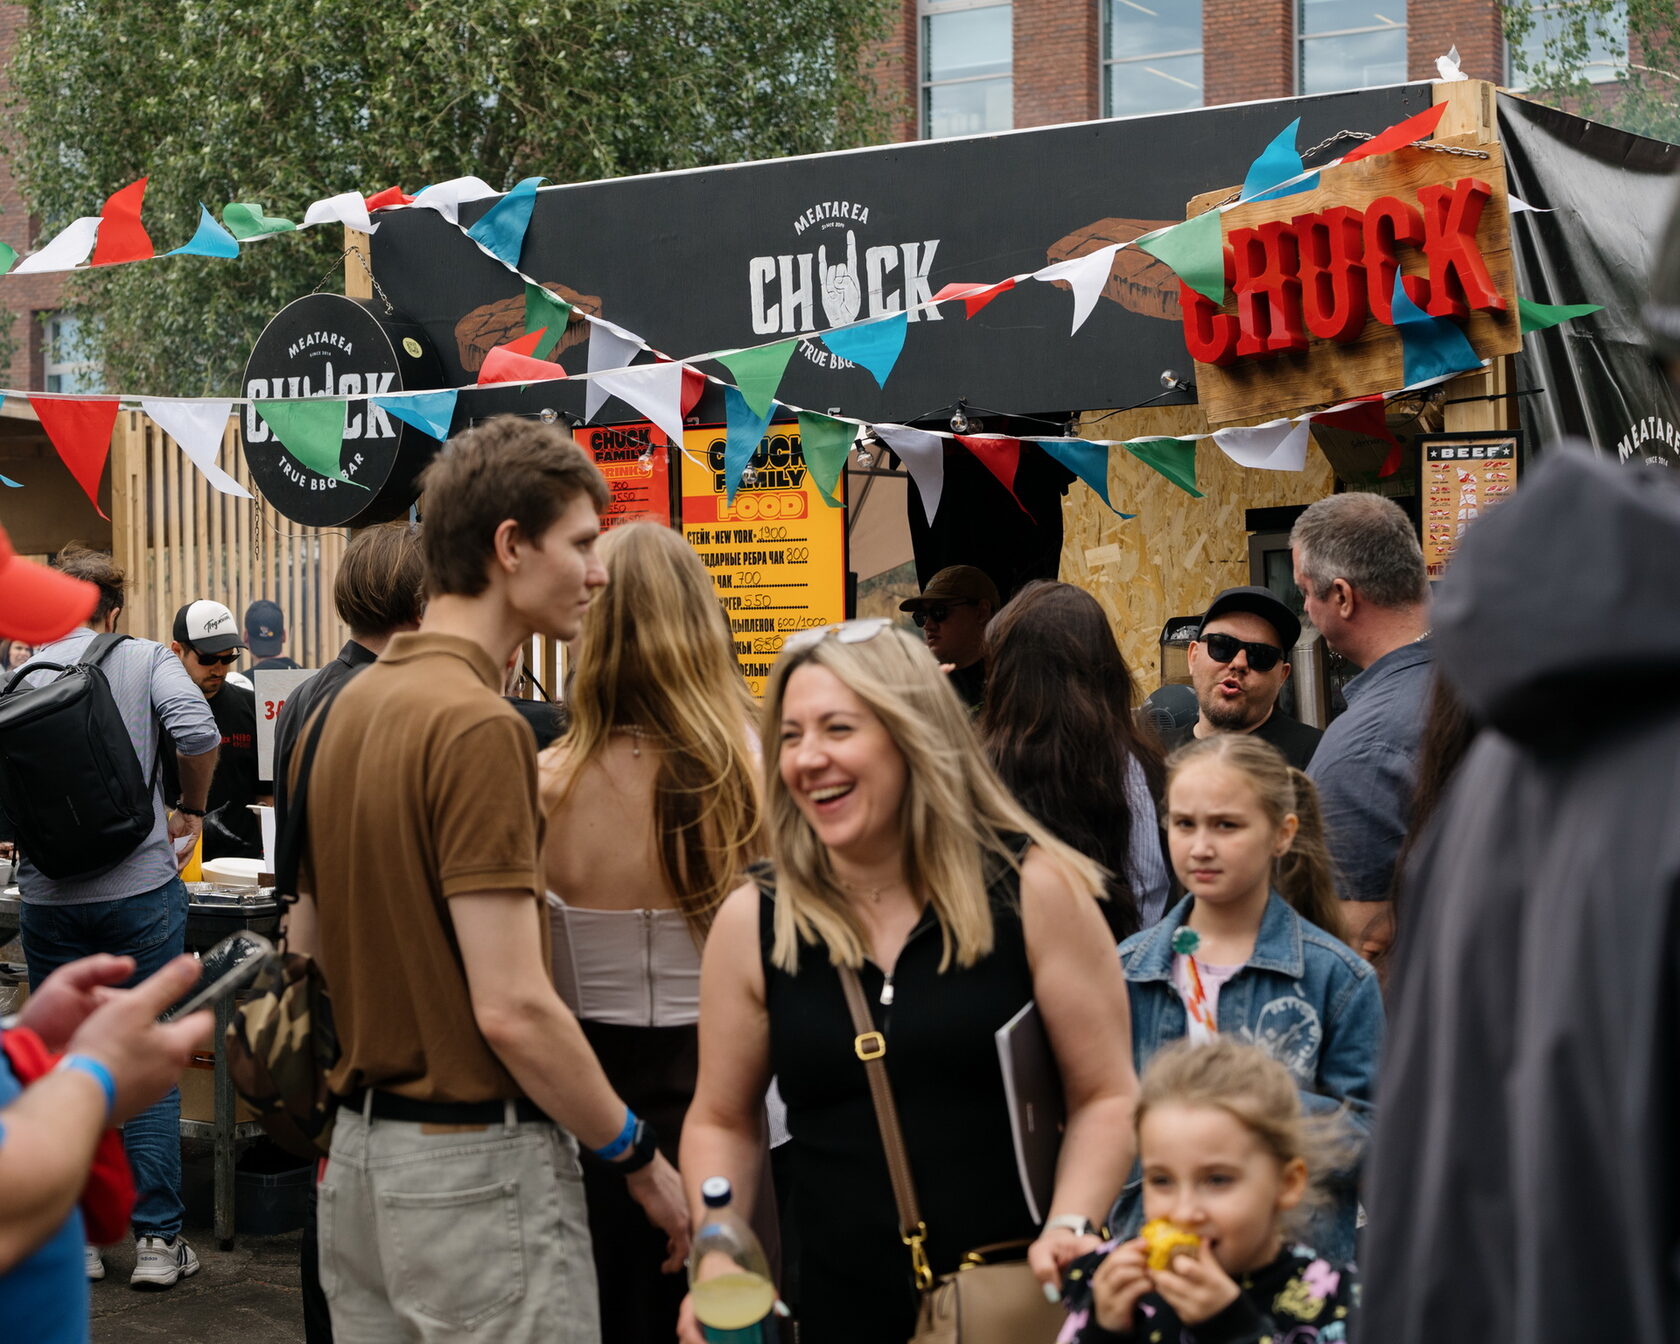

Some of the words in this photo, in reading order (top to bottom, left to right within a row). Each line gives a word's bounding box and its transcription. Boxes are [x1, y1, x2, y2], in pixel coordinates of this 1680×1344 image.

[794, 201, 869, 236] MEATAREA
[288, 331, 353, 359] MEATAREA
[799, 338, 828, 367] TRUE
[590, 427, 652, 452] CHUCK
[594, 448, 648, 464] FAMILY
[1441, 447, 1499, 458] BEEF
[279, 456, 306, 487] TRUE
[310, 477, 337, 491] BBQ
[341, 452, 364, 480] BAR
[717, 493, 805, 521] FOOD
[687, 528, 710, 545] СТЕЙК
[759, 526, 787, 540] 1900
[698, 552, 741, 568] ЕНДАРНЫЕ
[743, 551, 767, 565] РЕБРА
[769, 550, 784, 564] ЧАК
[786, 547, 809, 561] 800
[717, 575, 732, 588] ЧАК
[736, 571, 761, 585] 700
[744, 594, 771, 607] 550
[778, 616, 827, 629] 600/1000
[753, 635, 783, 651] 650
